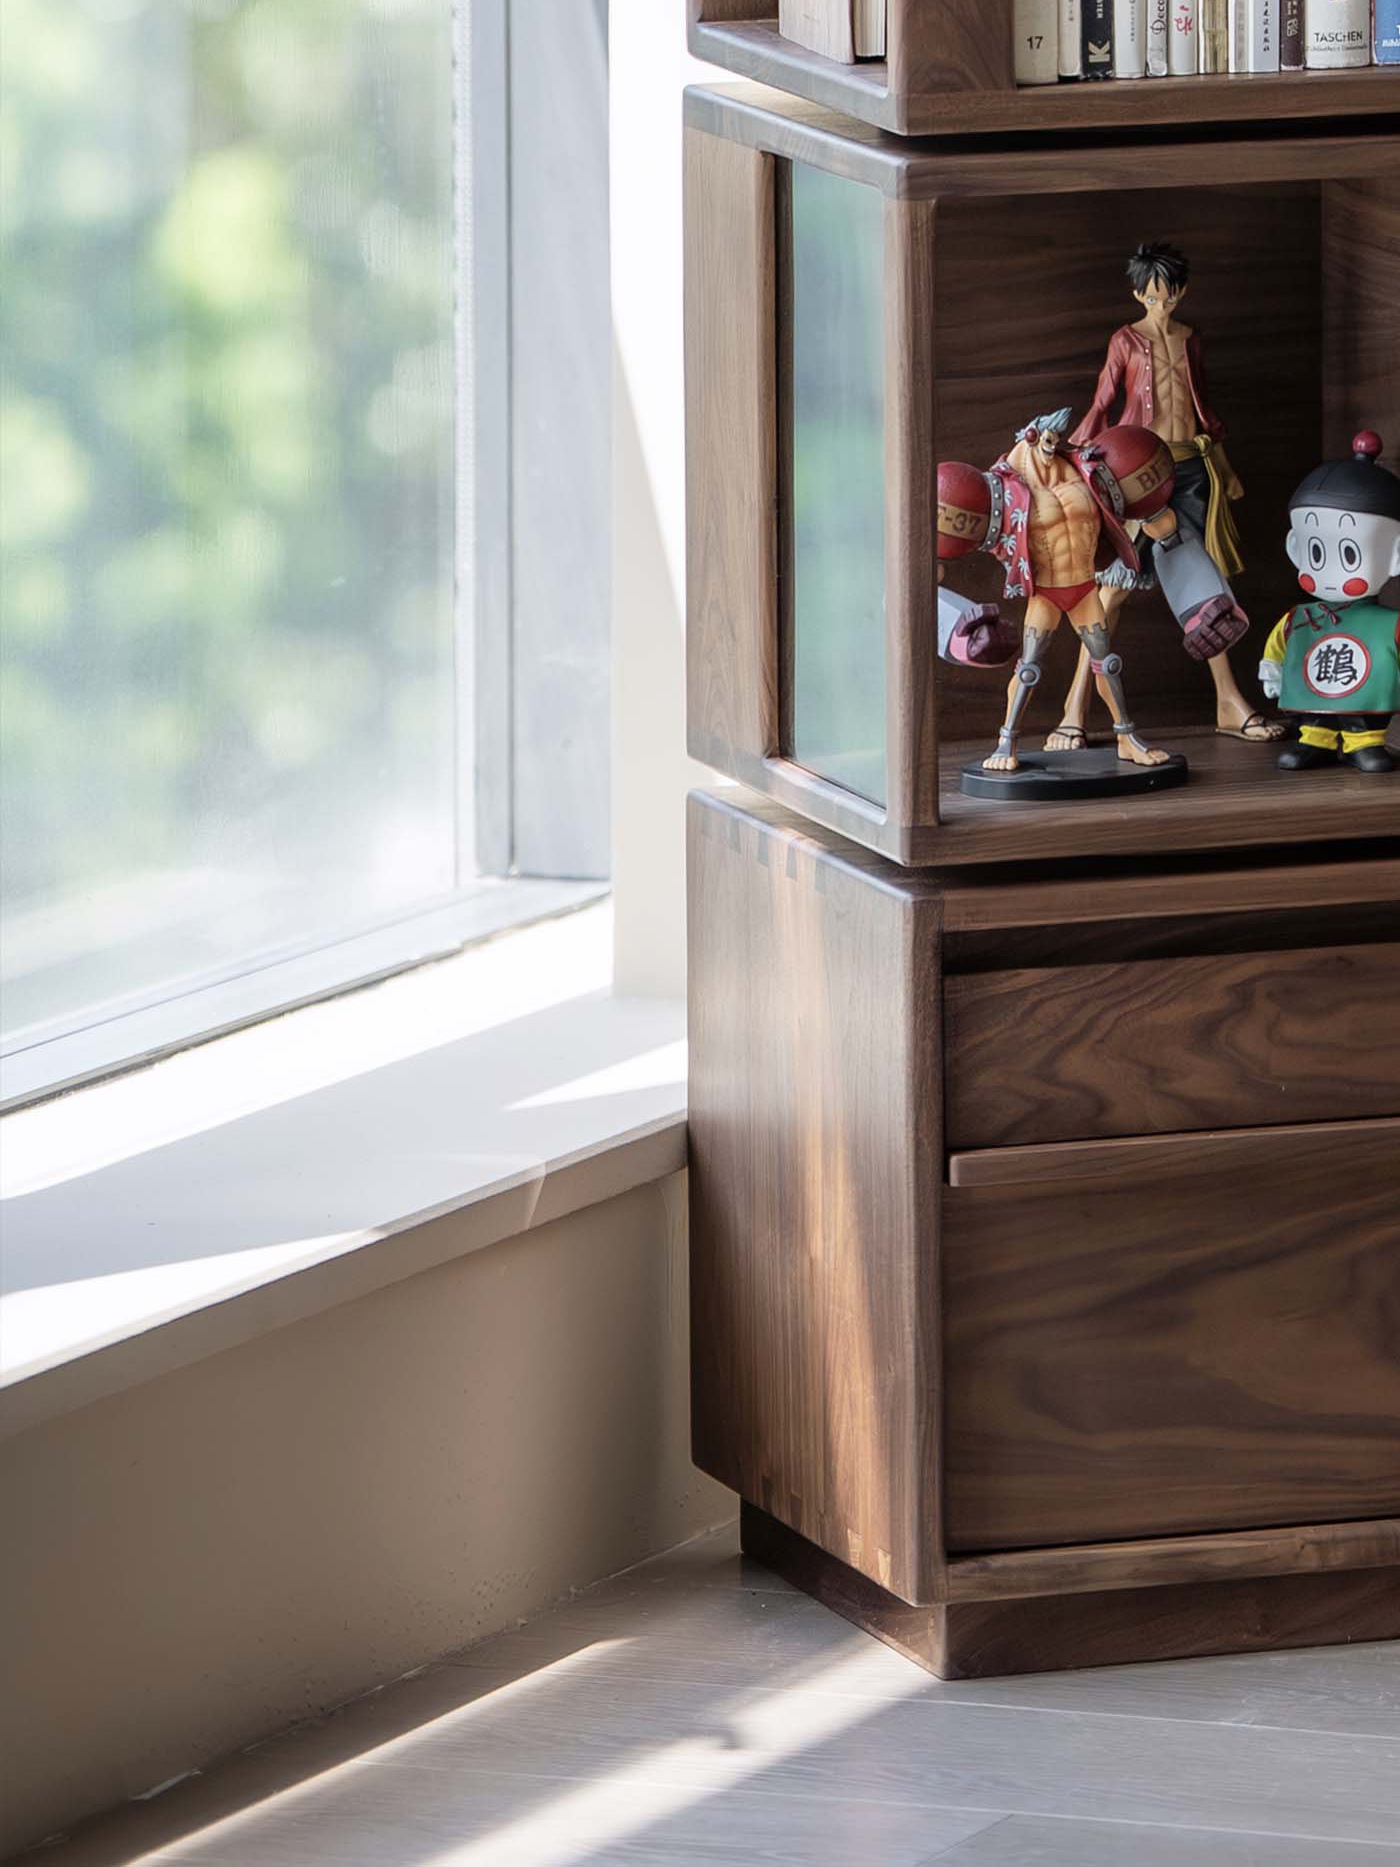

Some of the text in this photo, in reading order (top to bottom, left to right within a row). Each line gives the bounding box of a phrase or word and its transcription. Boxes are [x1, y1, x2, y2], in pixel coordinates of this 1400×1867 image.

[1150, 0, 1166, 35] Deco
[1027, 36, 1044, 50] 17
[1314, 31, 1363, 43] TASCHEN
[1313, 643, 1358, 686] 鶴
